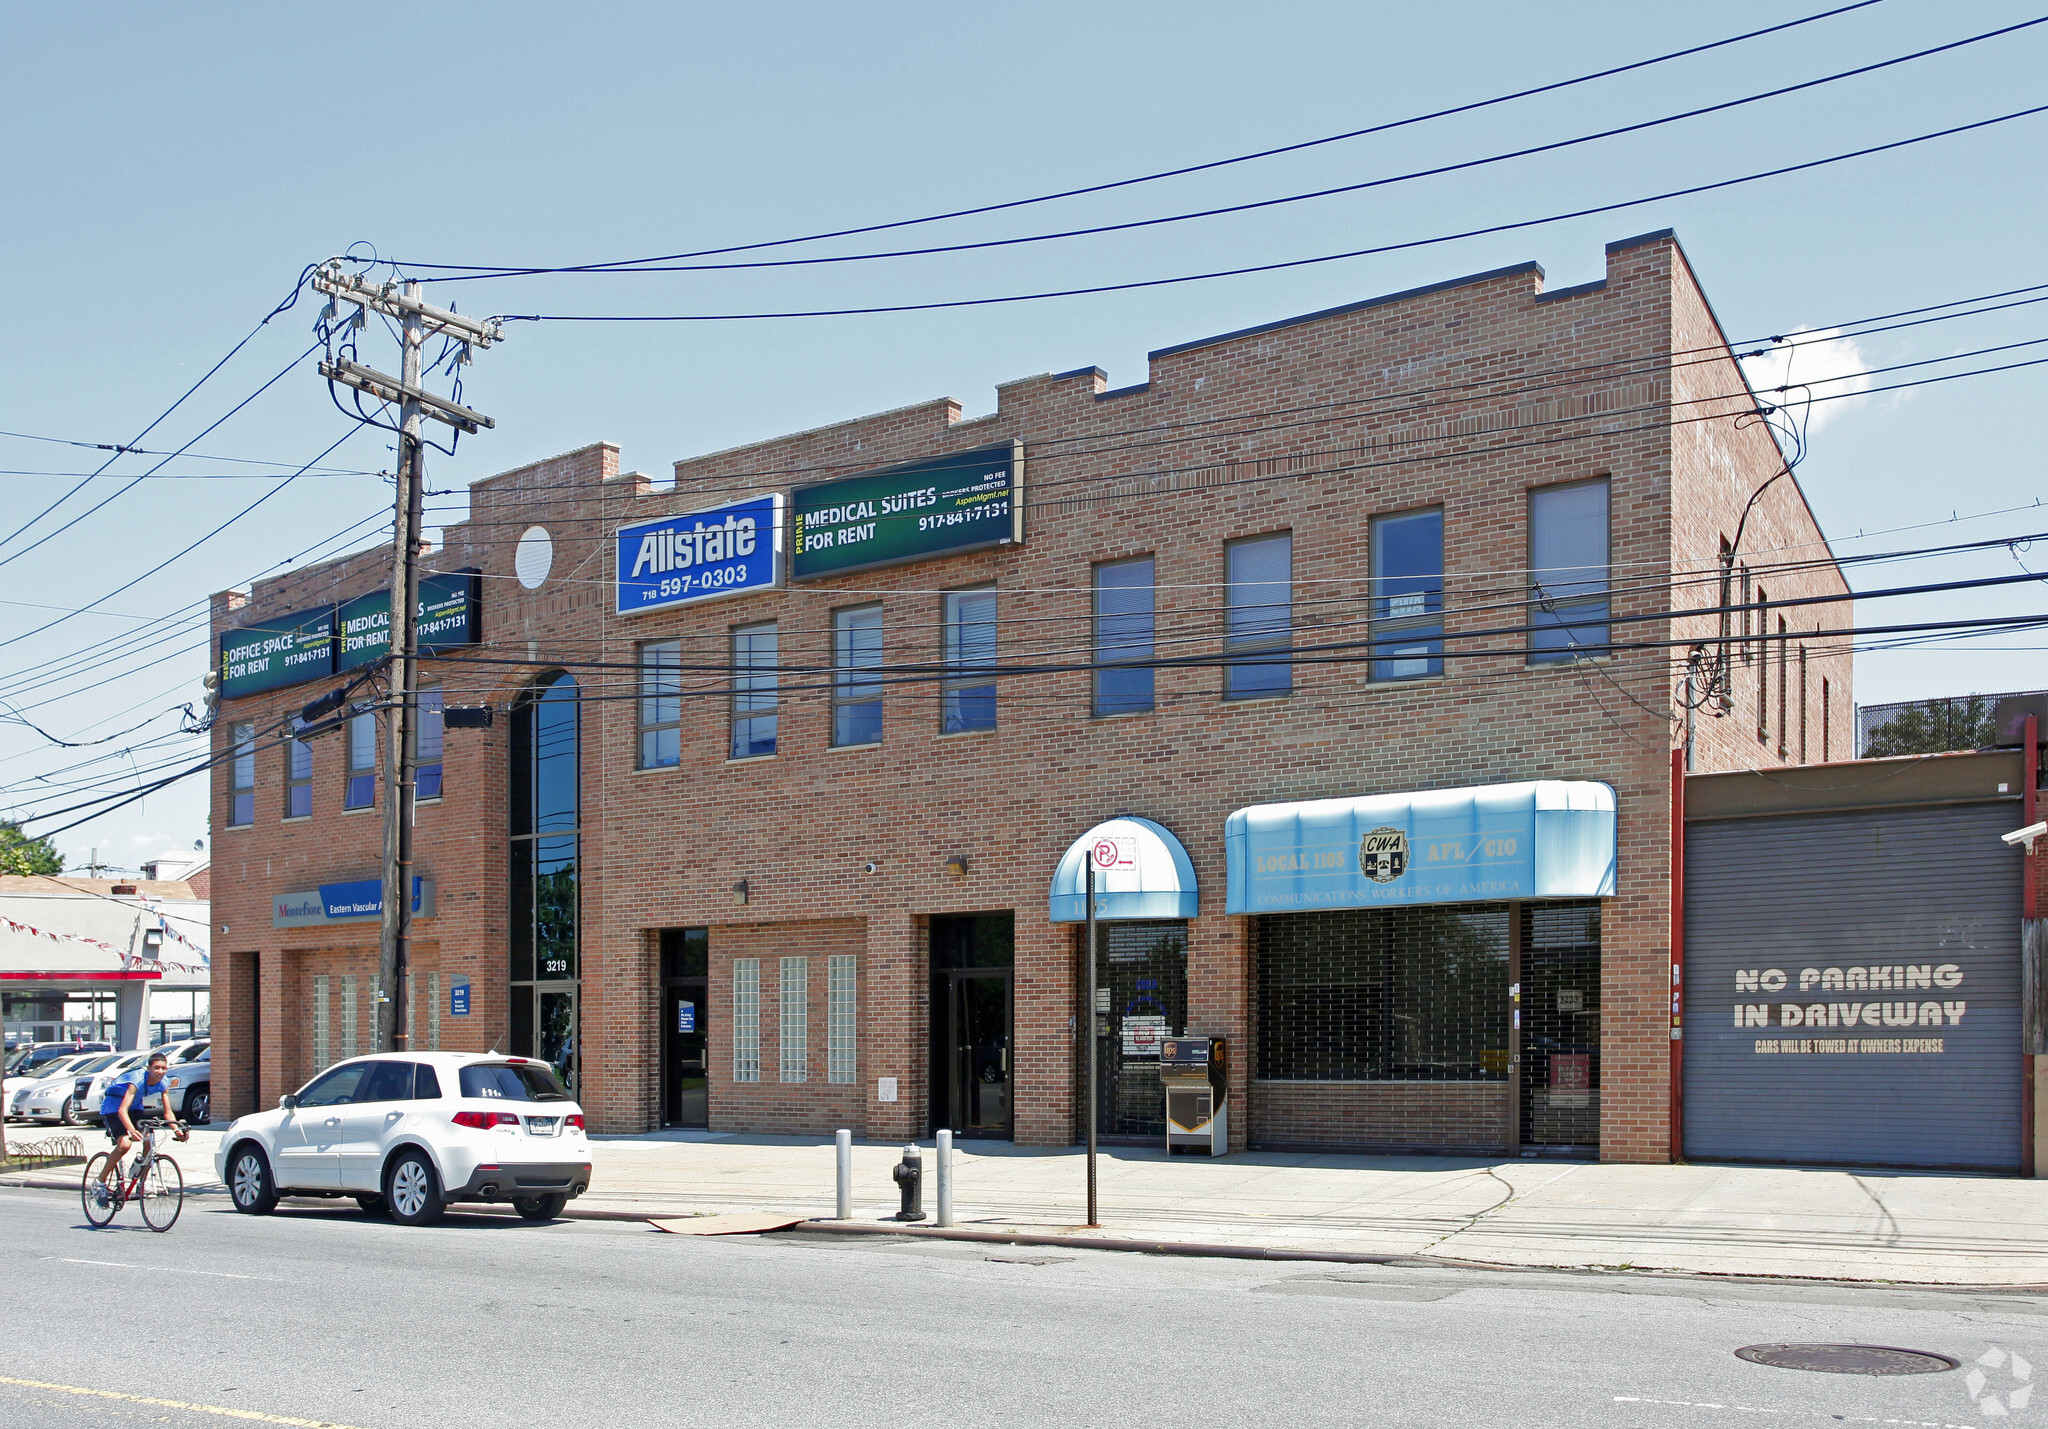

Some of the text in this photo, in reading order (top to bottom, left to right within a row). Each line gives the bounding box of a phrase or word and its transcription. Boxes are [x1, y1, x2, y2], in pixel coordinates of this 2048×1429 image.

[995, 470, 1006, 479] FEE
[971, 480, 1006, 492] PROTECTED
[955, 488, 1010, 506] AspenMgmt.net
[805, 486, 936, 530] MEDICAL SUITES
[795, 513, 804, 555] PRIME
[805, 522, 876, 552] FOR RENT
[631, 514, 756, 578] Allstate
[642, 564, 747, 600] 718 597-0303
[347, 612, 390, 634] MEDICAL
[230, 634, 293, 663] OFFICE SPACE
[347, 630, 389, 651] FOR RENT
[230, 658, 270, 679] FOR RENT
[1366, 836, 1400, 852] CWA
[1257, 852, 1344, 872] LOCAL 1105
[1258, 880, 1520, 905] COMMUNICATIONS WORKERS OF AMERICA
[279, 901, 322, 917] Montefiore
[330, 905, 351, 914] Eastern
[352, 902, 377, 912] Vascular
[1074, 898, 1108, 915] 115
[546, 960, 566, 972] 3219
[1736, 964, 1964, 992] NO PARKING
[1734, 1001, 1966, 1027] IN DRIVEWAY
[1165, 1048, 1176, 1056] ups
[1755, 1039, 1944, 1053] CARS WILL BE TOWED AT OWNERS EXPENSE
